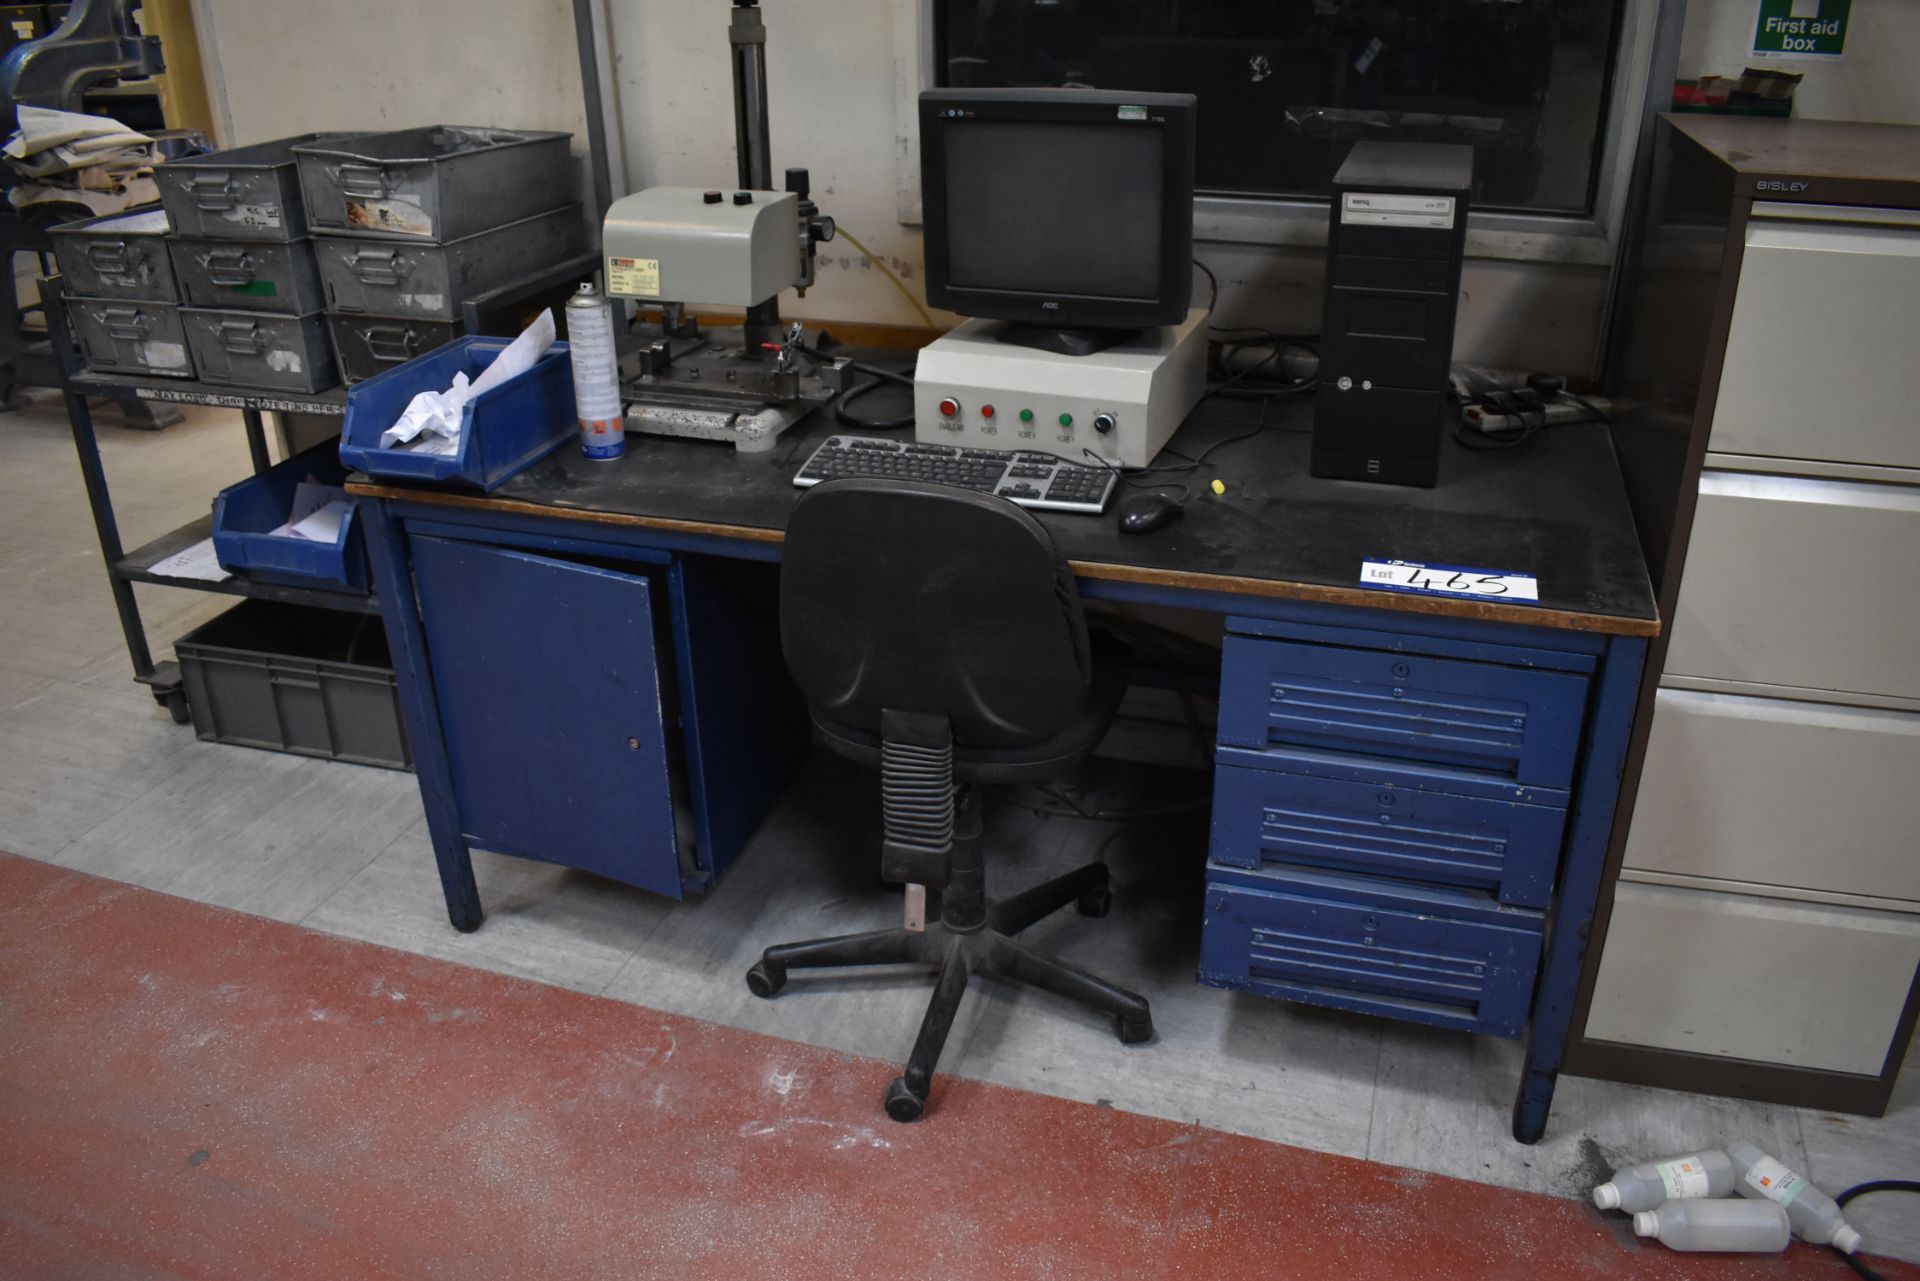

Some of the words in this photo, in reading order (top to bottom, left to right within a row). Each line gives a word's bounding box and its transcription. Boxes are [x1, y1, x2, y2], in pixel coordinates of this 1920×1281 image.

[1765, 17, 1807, 34] First
[1810, 19, 1840, 36] aid
[1782, 34, 1816, 51] box
[1756, 180, 1809, 191] BISLEY
[1370, 568, 1394, 579] Lot
[1407, 569, 1508, 594] 465
